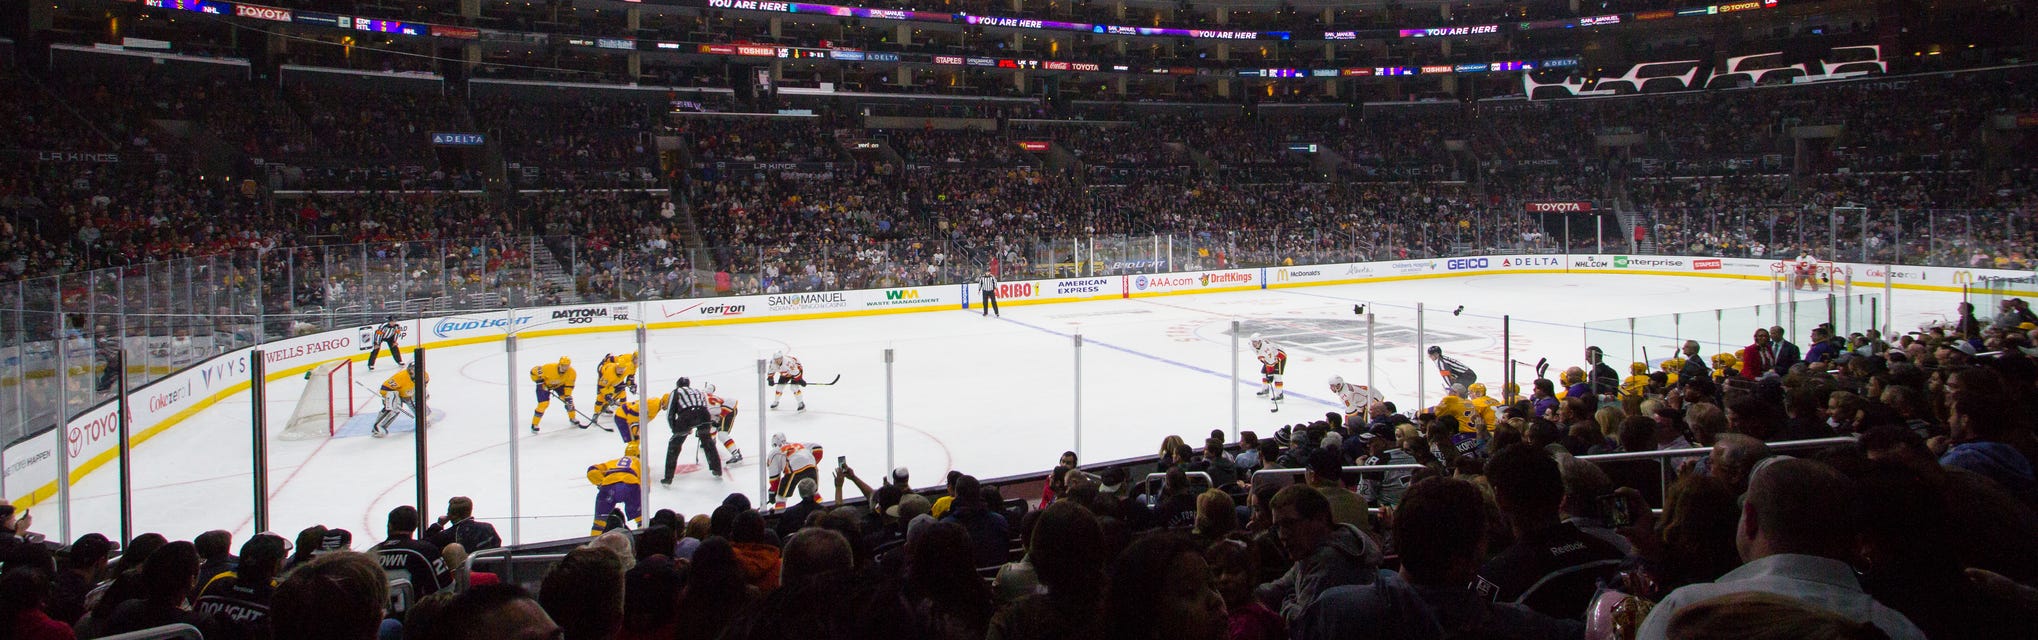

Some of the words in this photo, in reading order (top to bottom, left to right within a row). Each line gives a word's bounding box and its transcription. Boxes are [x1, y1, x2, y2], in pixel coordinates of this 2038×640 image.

[203, 6, 219, 14] NHL
[709, 0, 732, 8] YOU
[734, 1, 757, 10] ARE
[759, 2, 789, 12] HERE
[1730, 2, 1760, 11] TOYOTA
[237, 6, 292, 21] TOYOTA
[979, 17, 997, 25] YOU
[999, 18, 1017, 26] ARE
[1019, 19, 1042, 29] HERE
[1199, 30, 1216, 38] YOU
[1217, 31, 1233, 39] ARE
[1234, 32, 1257, 40] HERE
[1428, 28, 1449, 36] YOU
[1451, 26, 1468, 35] ARE
[1471, 25, 1498, 34] HERE
[739, 47, 774, 56] TOSHIBA
[875, 53, 898, 61] DELTA
[936, 56, 962, 65] STAPLES
[1072, 63, 1099, 71] TOYOTA
[1422, 66, 1452, 74] TOSHIBA
[446, 135, 483, 143] DELTA
[1535, 203, 1580, 212] TOYOTA
[1447, 257, 1489, 270] GEICO
[1515, 257, 1559, 266] DELTA
[1210, 271, 1252, 284] DraftKings
[1290, 270, 1320, 278] McDonald's
[1058, 279, 1107, 289] AMERICAN
[1150, 277, 1193, 288] AAA.com
[993, 283, 1032, 299] ARIBO
[1057, 286, 1099, 296] EXPRESS
[768, 295, 791, 306] SAN
[801, 293, 846, 304] MANUEL
[891, 297, 939, 306] MANAGEMENT
[552, 308, 608, 320] DAYTONA
[700, 303, 745, 316] verizon
[568, 316, 592, 324] 500
[613, 313, 629, 321] FOX
[441, 321, 479, 333] BUD
[266, 345, 304, 364] WELLS
[306, 337, 350, 356] FARGO
[84, 403, 133, 445] TOYOA
[378, 554, 408, 567] OWN
[199, 601, 266, 622] DOUGHT
